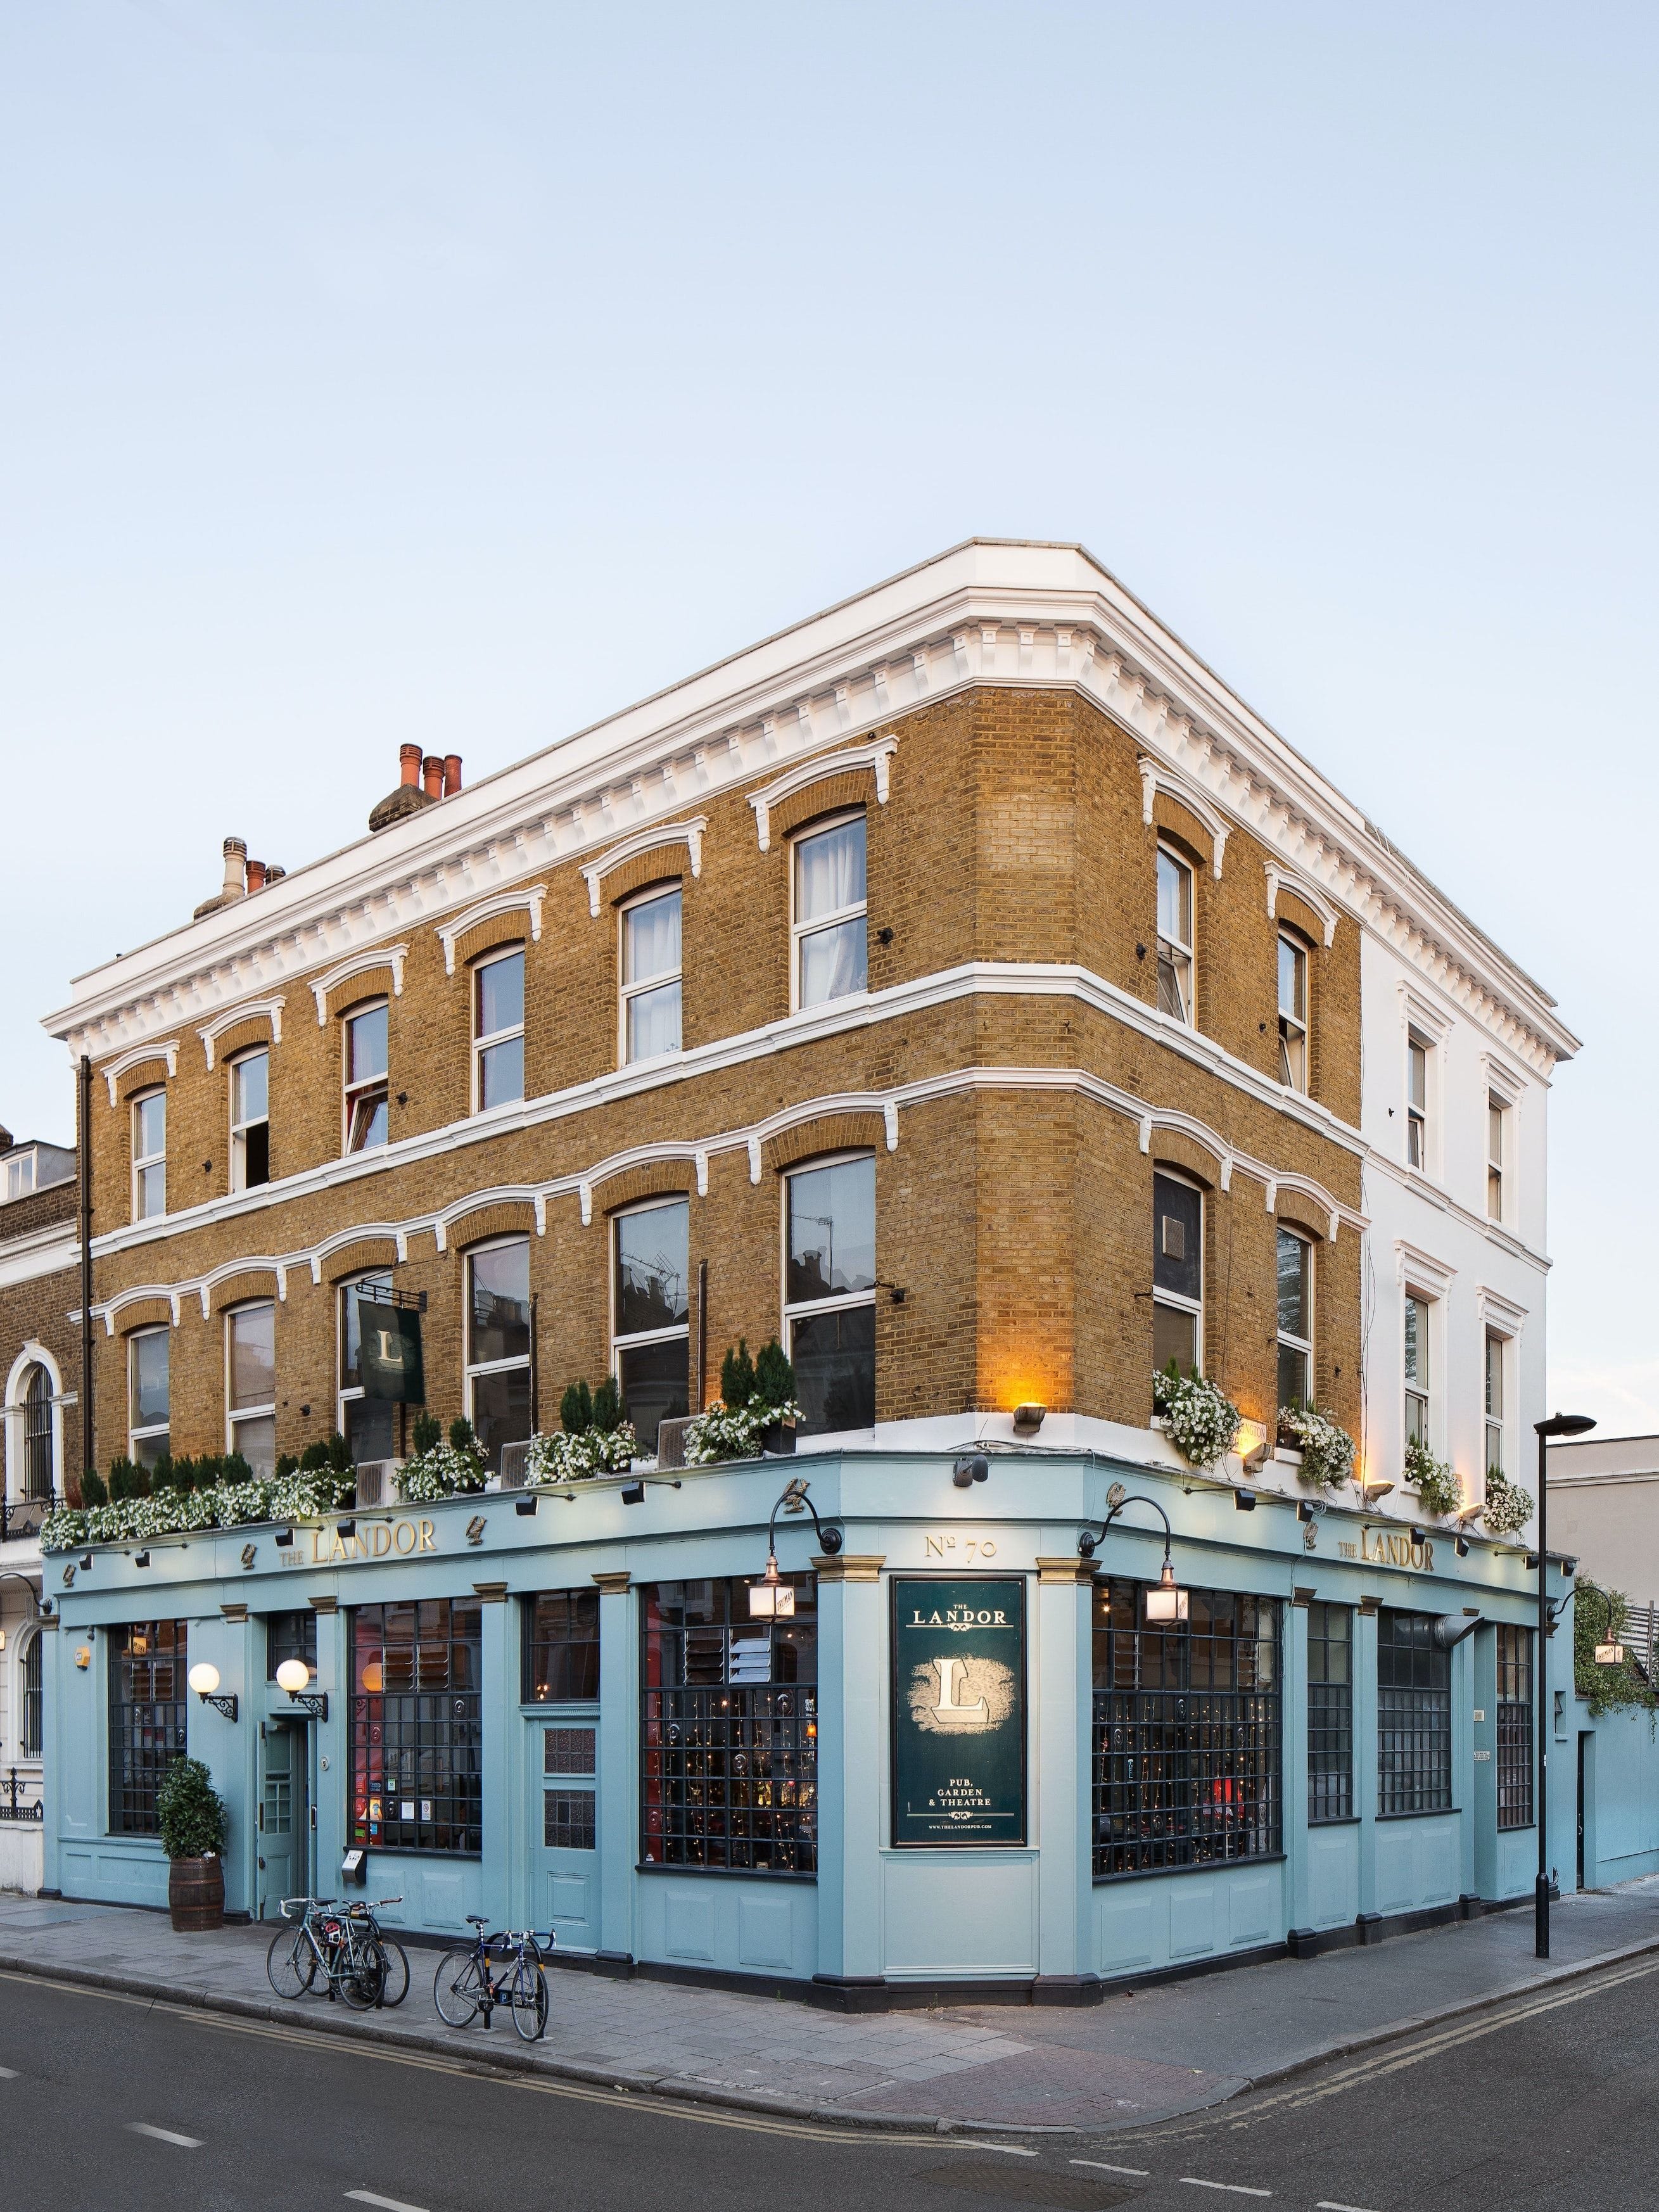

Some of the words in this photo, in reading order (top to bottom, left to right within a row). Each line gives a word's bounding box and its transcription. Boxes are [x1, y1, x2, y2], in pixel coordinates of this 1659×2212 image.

[377, 1330, 404, 1364] L
[279, 1549, 305, 1567] THE
[312, 1519, 437, 1563] LANDOR
[965, 1540, 997, 1563] 70
[1337, 1541, 1357, 1558] THE
[1361, 1529, 1435, 1572] LANDOR
[913, 1610, 1007, 1624] LANDOR
[1597, 1647, 1613, 1660] TRUMAN
[931, 1658, 989, 1724] L
[950, 1779, 973, 1787] PUB,
[940, 1798, 991, 1806] THEATRE
